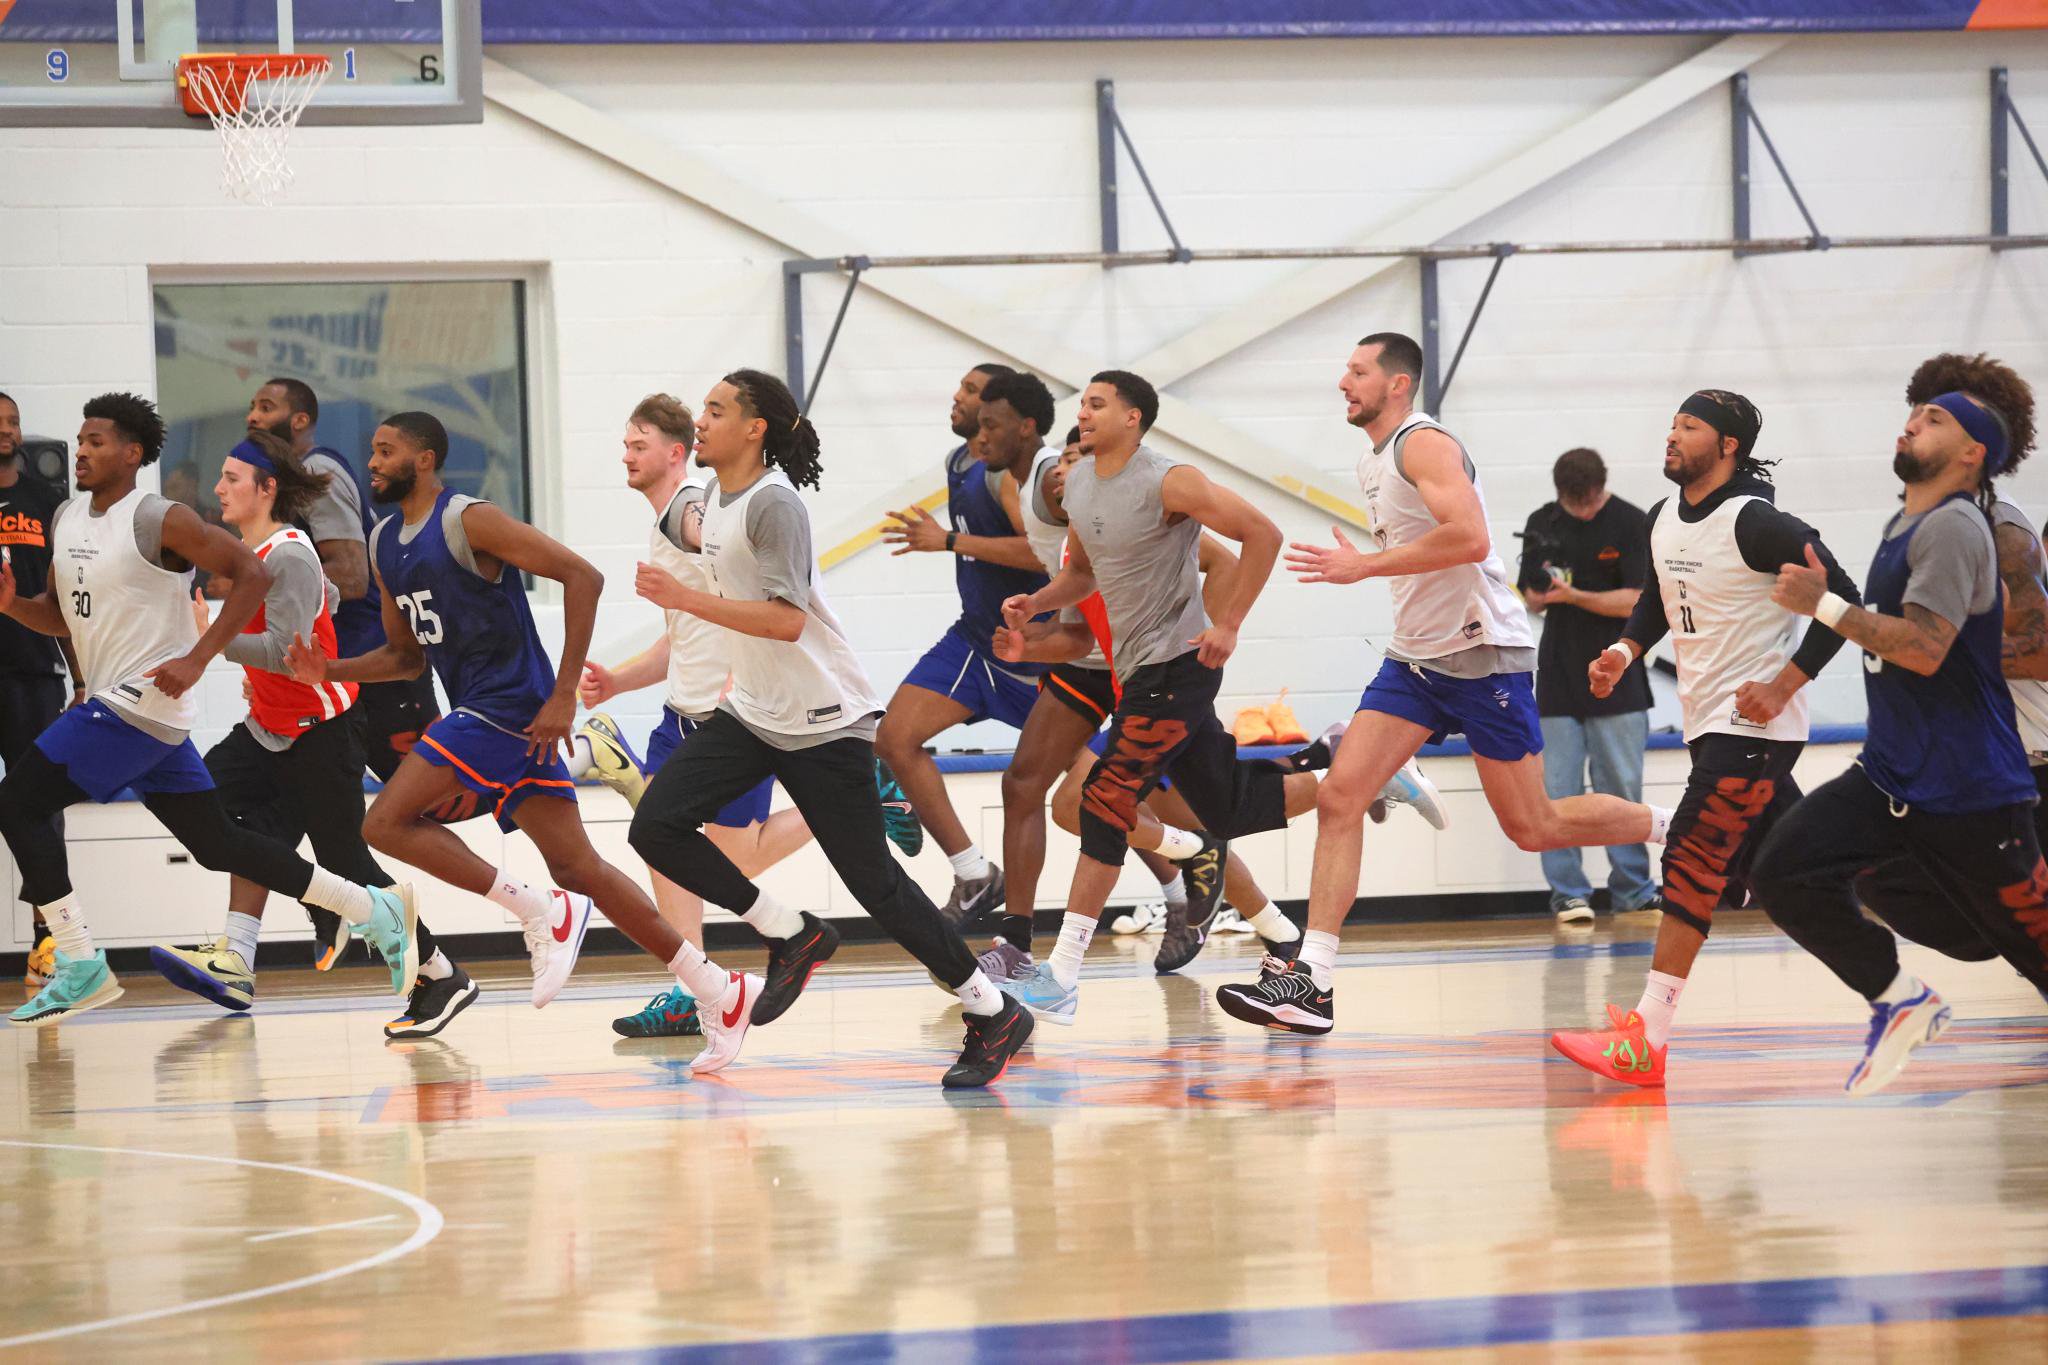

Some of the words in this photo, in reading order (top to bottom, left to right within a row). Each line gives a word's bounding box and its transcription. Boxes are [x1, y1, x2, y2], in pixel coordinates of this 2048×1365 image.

[46, 48, 69, 83] 9
[344, 48, 356, 80] 1
[420, 54, 438, 82] 6
[1669, 566, 1696, 574] BASKETBALL
[71, 590, 91, 618] 30
[395, 589, 444, 645] 25
[1680, 605, 1696, 633] 11
